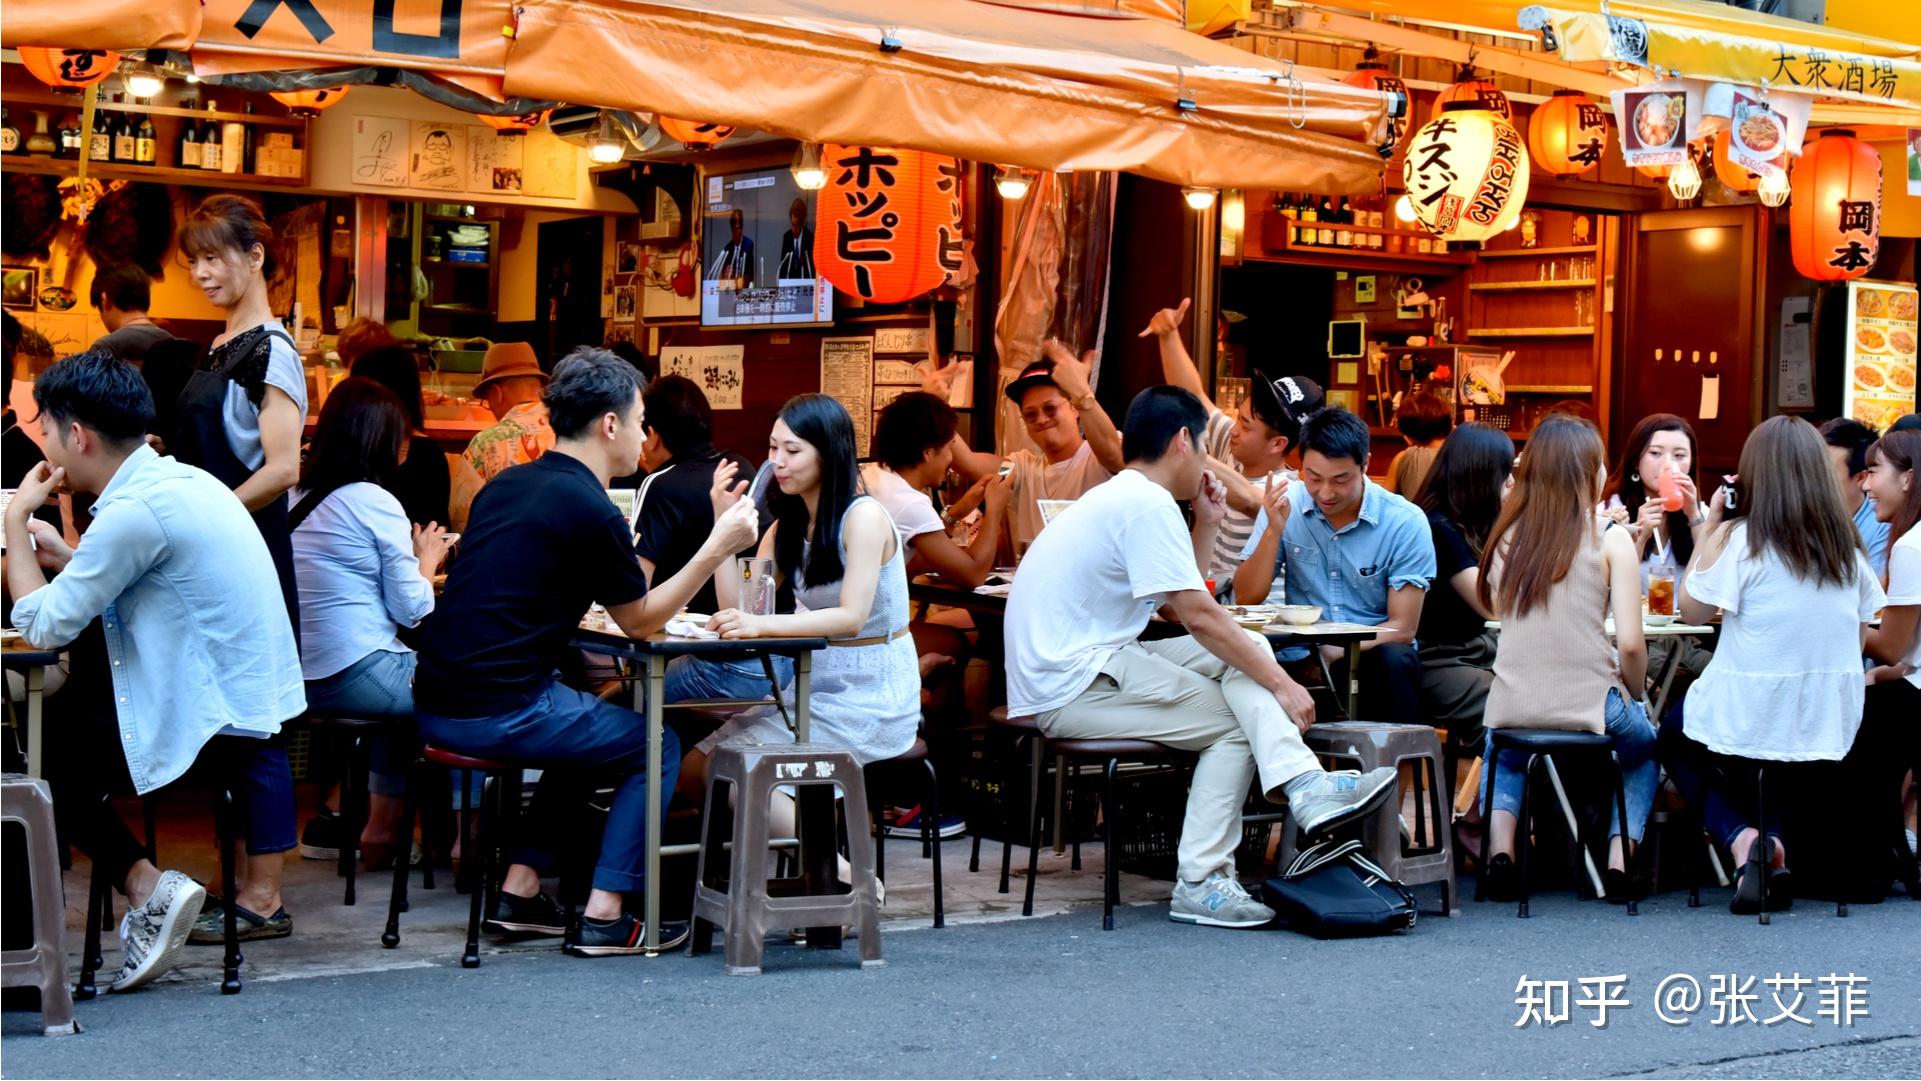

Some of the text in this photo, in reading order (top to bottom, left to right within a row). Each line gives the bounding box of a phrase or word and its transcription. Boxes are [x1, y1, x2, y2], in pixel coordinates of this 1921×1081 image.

[1771, 42, 1899, 100] 大衆酒場
[1417, 118, 1458, 207] 牛スジ
[1568, 103, 1608, 167] 岡本
[836, 146, 899, 298] ホッピー
[1829, 199, 1875, 272] 岡本
